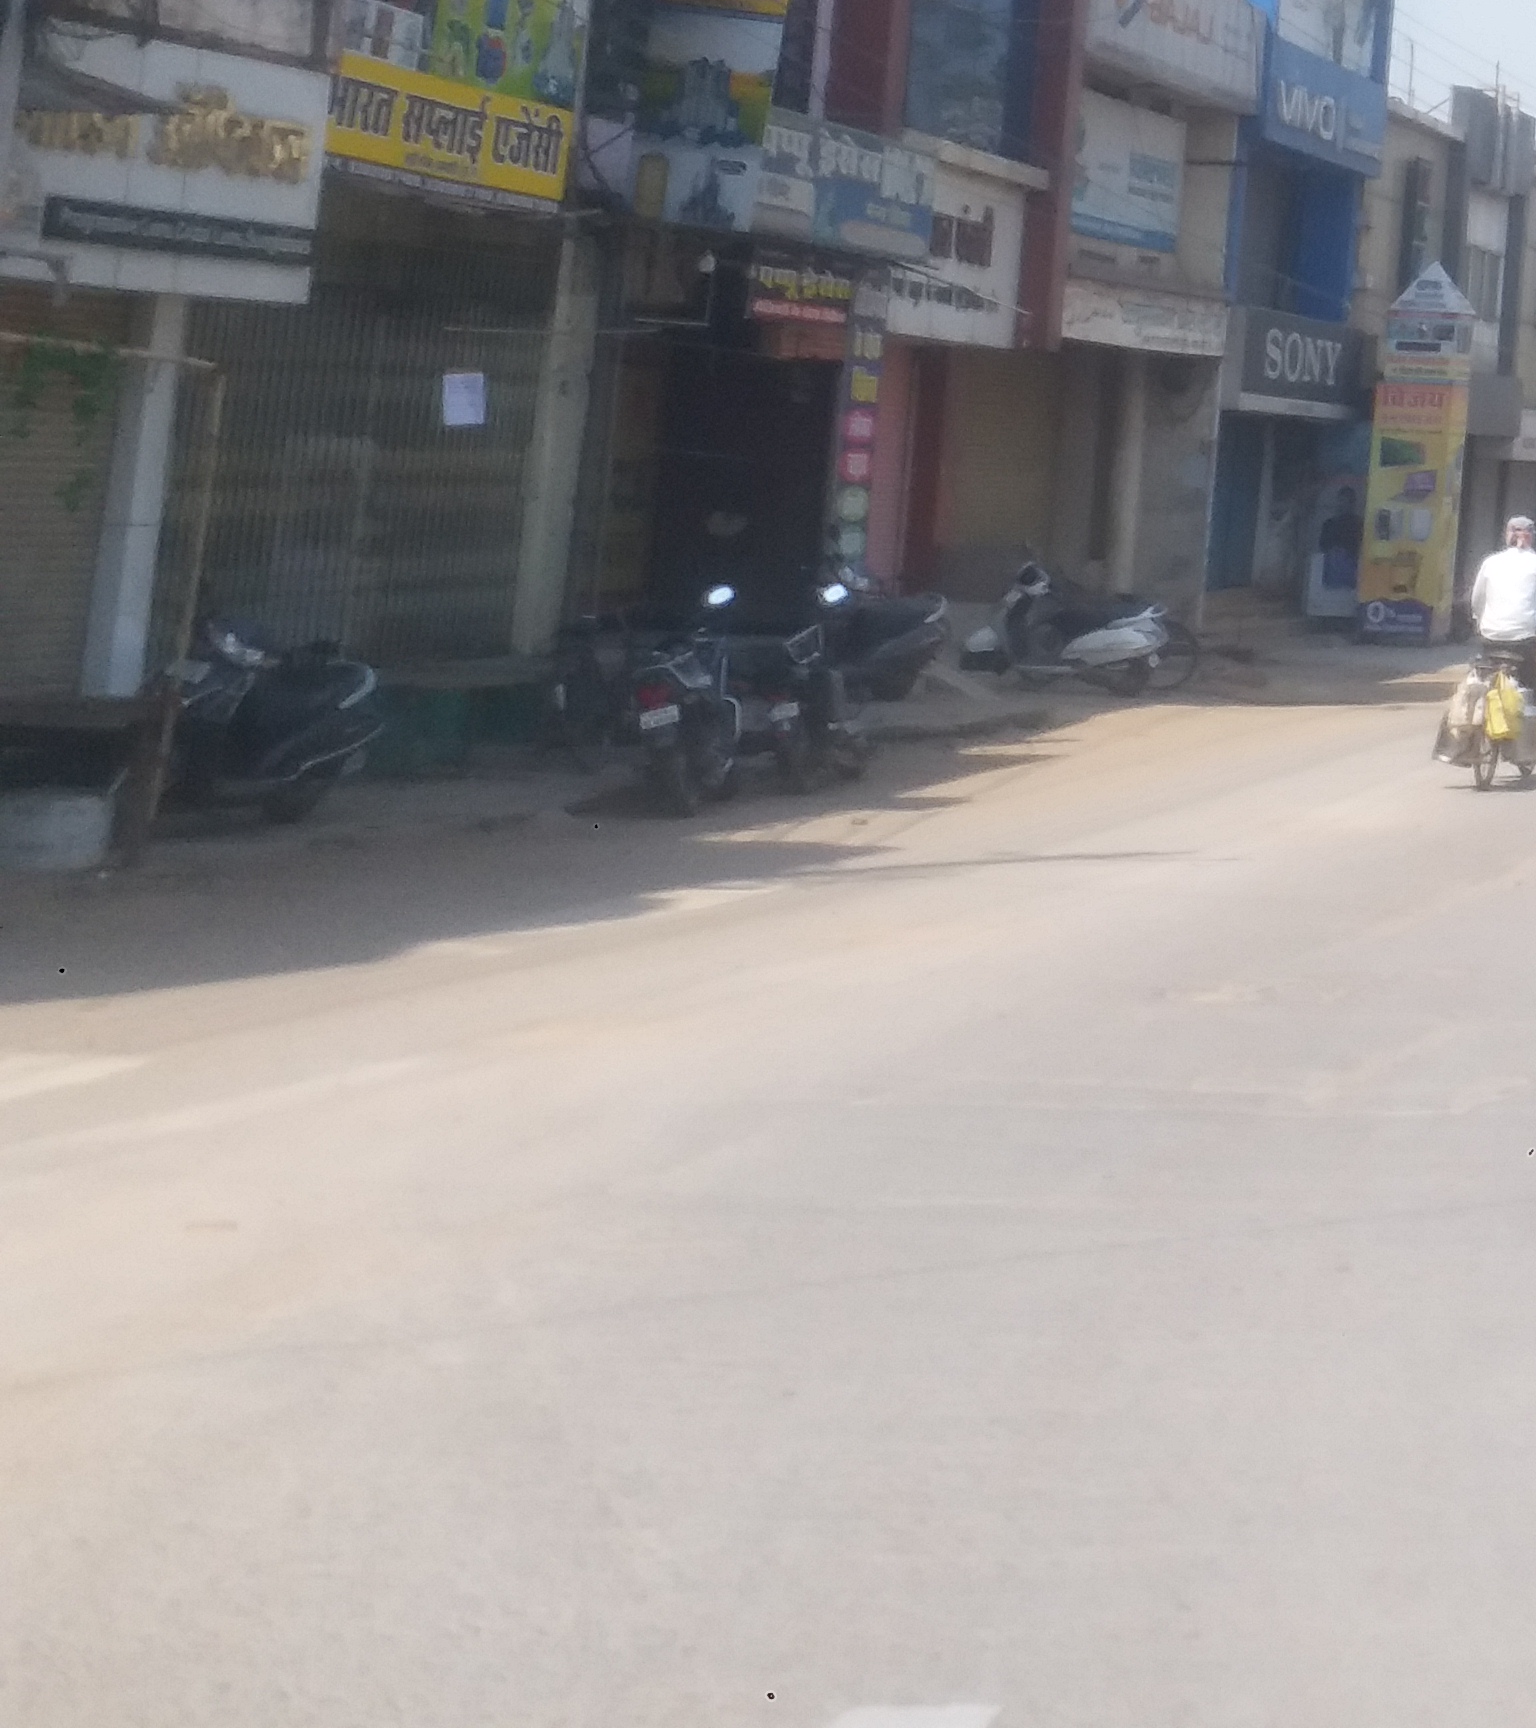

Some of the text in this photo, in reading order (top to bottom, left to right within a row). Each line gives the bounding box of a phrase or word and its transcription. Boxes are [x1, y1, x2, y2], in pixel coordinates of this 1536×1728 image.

[402, 94, 492, 165] सप्लाई
[492, 104, 563, 176] एजेंसी
[1264, 328, 1342, 386] SONY
